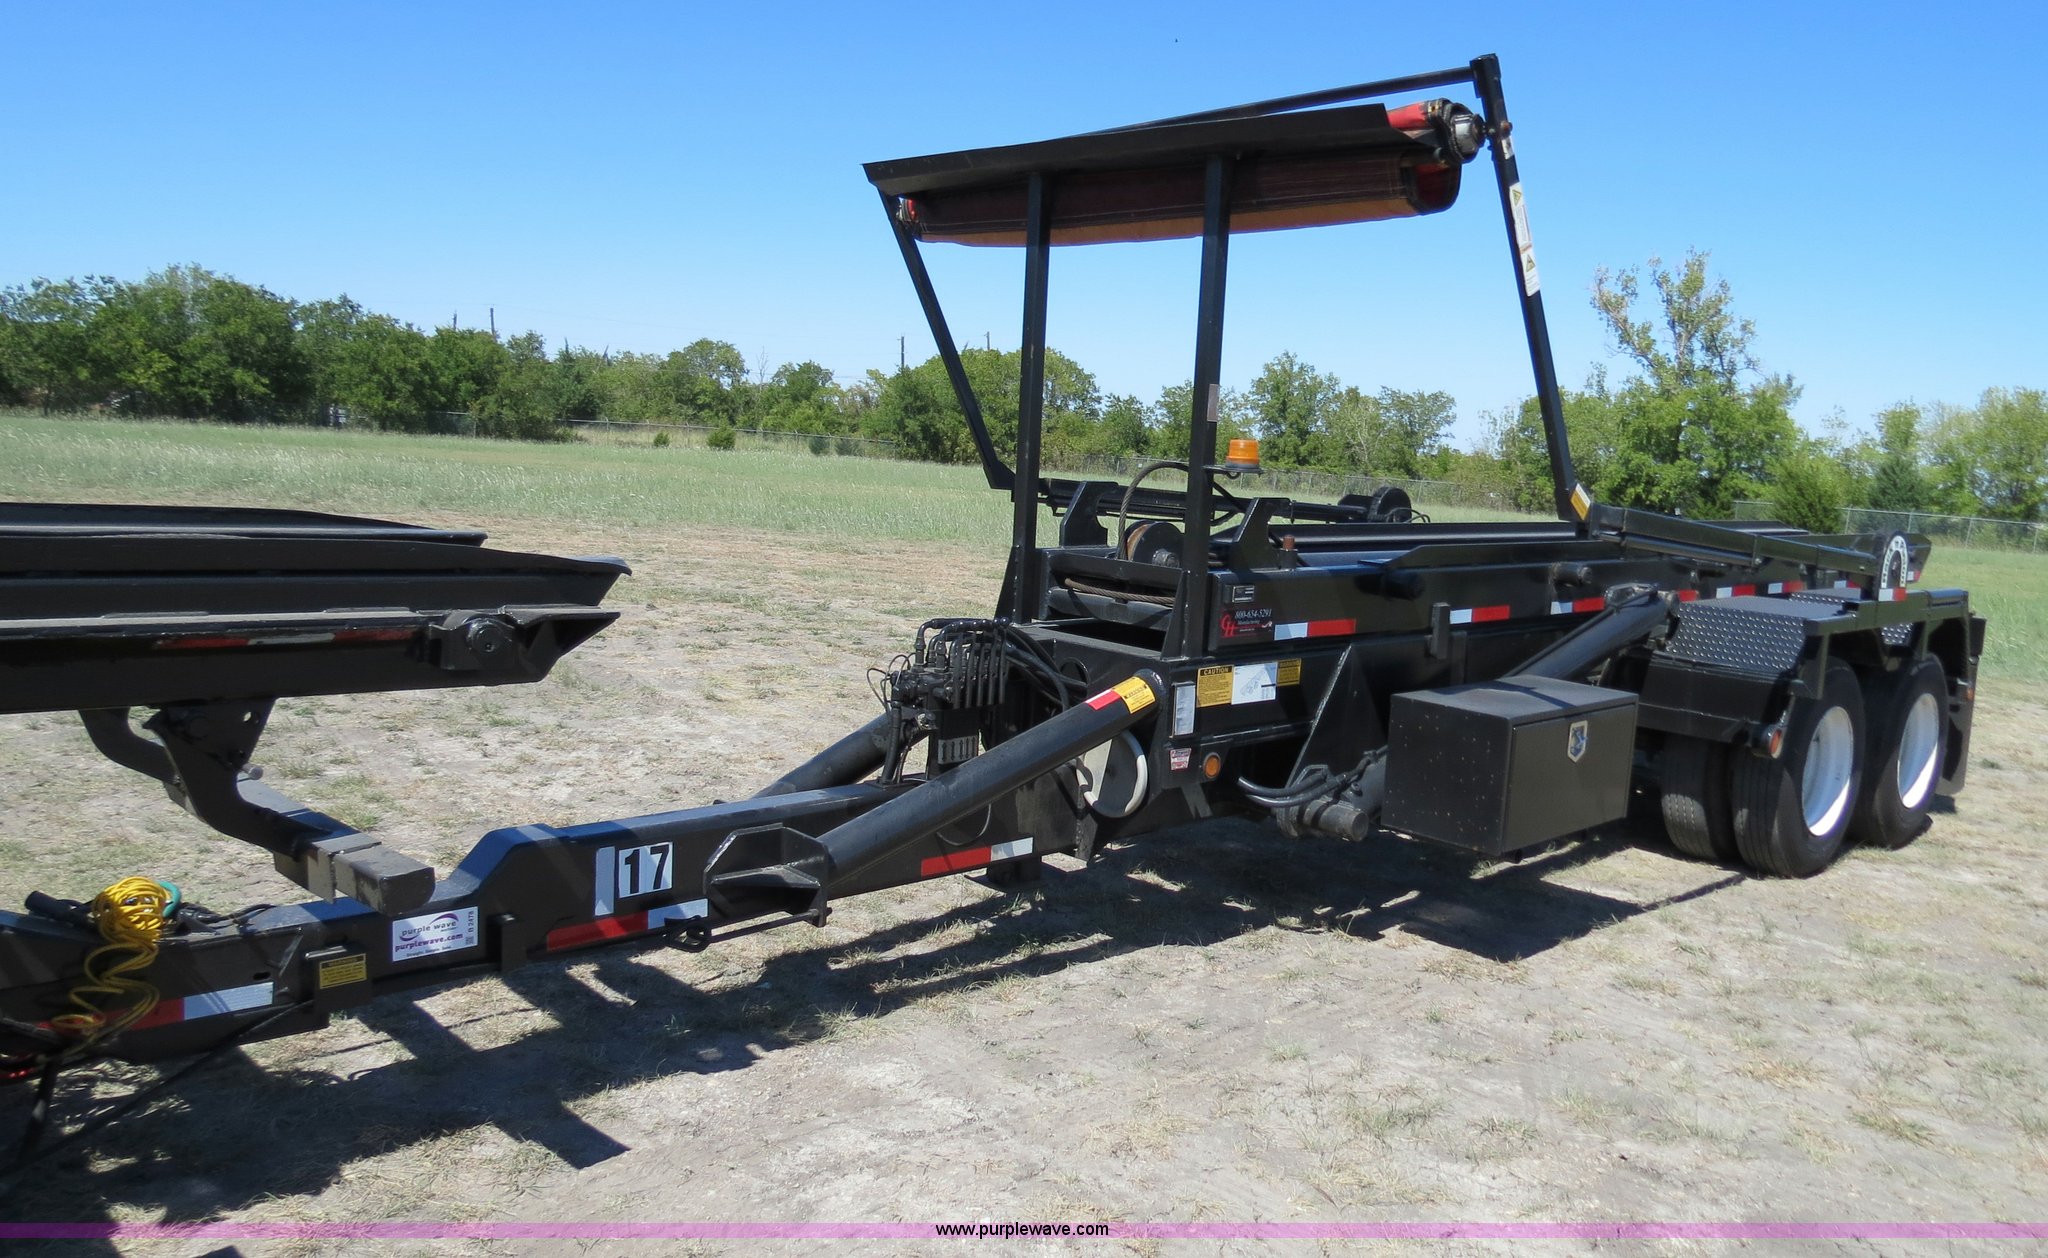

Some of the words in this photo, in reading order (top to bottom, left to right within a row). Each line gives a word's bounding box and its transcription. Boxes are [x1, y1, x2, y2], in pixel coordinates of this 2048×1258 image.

[1203, 667, 1229, 676] CAUTION
[624, 844, 670, 894] 17
[401, 925, 431, 936] purple
[433, 921, 457, 930] wave
[395, 933, 463, 952] purplewave.com
